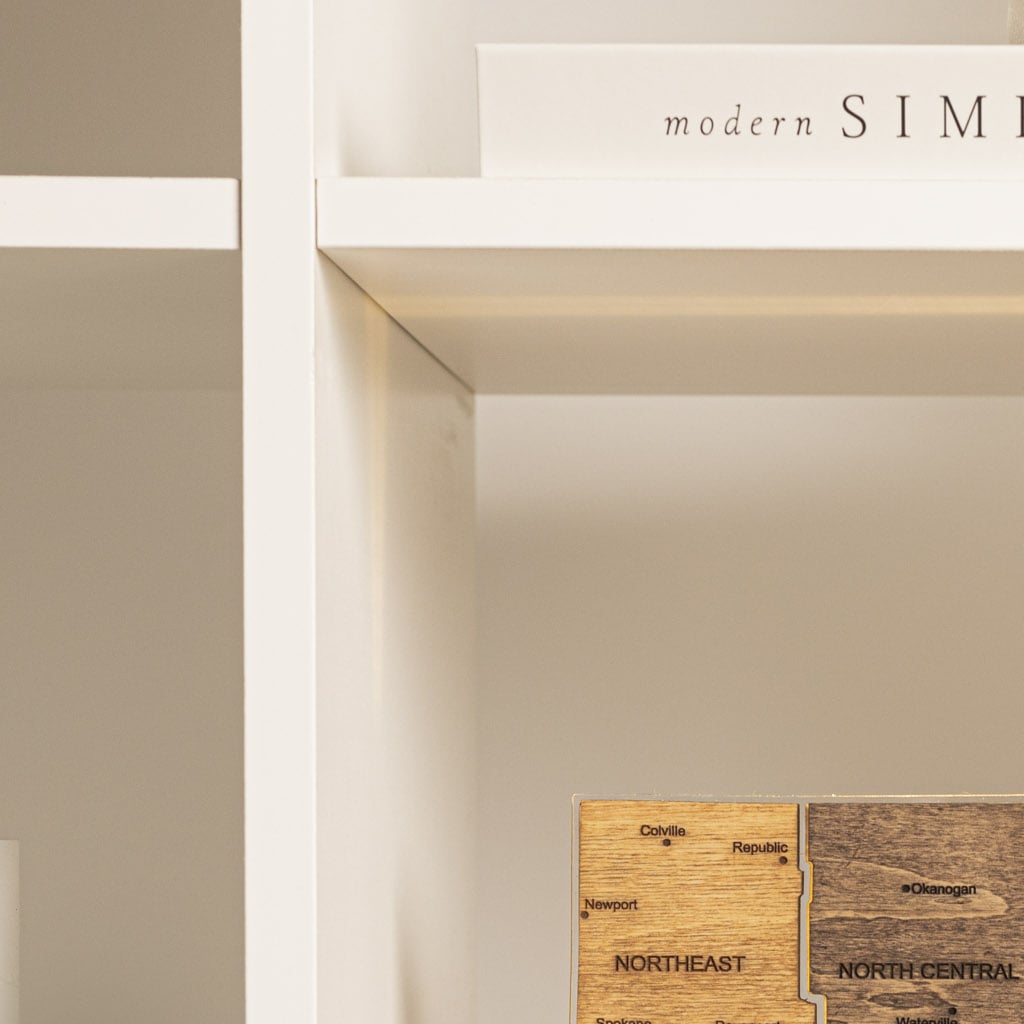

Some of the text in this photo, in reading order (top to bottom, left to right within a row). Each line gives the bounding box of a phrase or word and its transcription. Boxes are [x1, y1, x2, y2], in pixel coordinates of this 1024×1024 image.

[664, 105, 814, 137] modern
[640, 825, 686, 837] Colville
[732, 842, 788, 854] Republic
[911, 883, 976, 897] Okanogan
[584, 899, 638, 912] Newport
[615, 955, 746, 972] NORTHEAST
[839, 963, 1020, 980] NORTH CENTRAL
